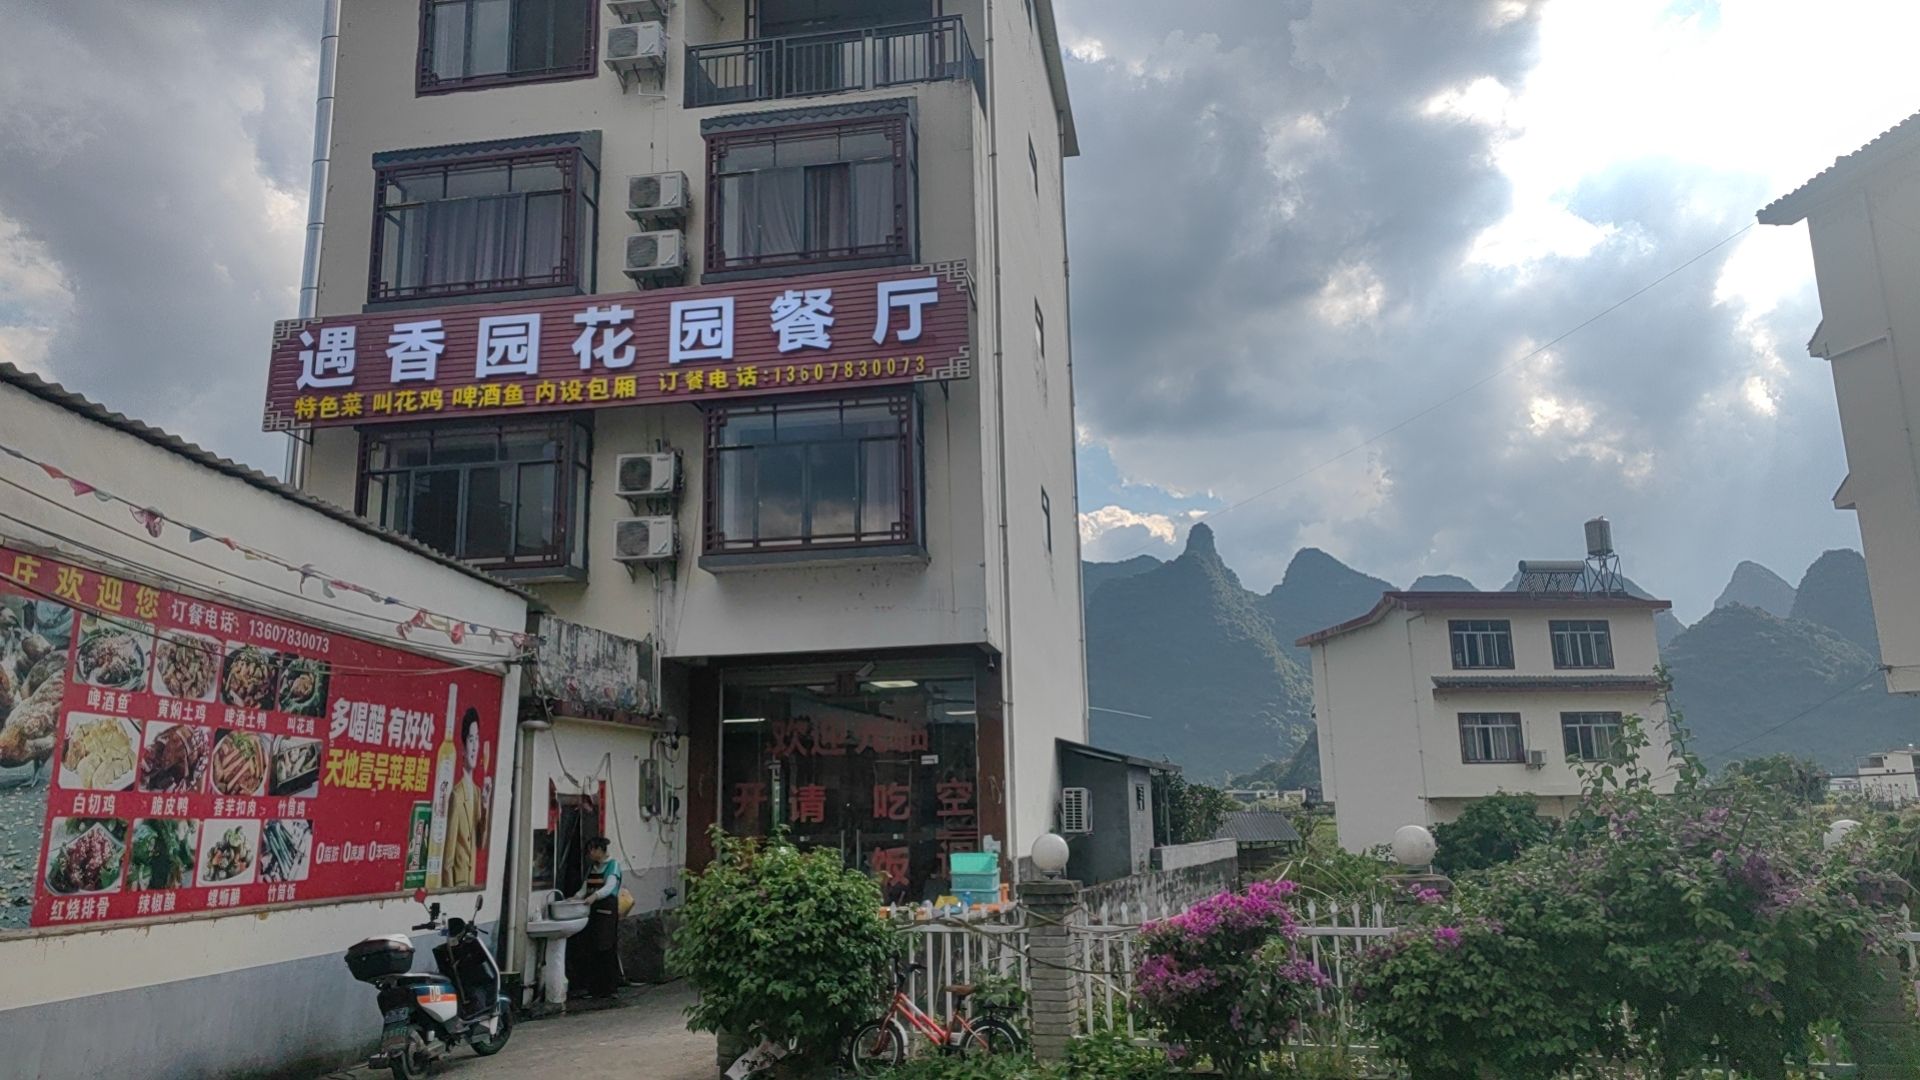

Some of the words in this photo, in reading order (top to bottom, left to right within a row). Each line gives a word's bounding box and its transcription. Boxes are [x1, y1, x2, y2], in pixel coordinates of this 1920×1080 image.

[296, 277, 939, 390] 遇香园花园餐厅
[294, 392, 363, 420] 特色菜
[372, 387, 443, 414] 叫花鸡
[452, 382, 525, 409] 啤酒鱼
[535, 374, 638, 402] 内设包厢
[12, 555, 161, 619] 庄欢迎您
[87, 687, 132, 714] 啤酒鱼
[224, 708, 267, 730] 啤酒土鸭
[287, 716, 315, 735] 叫花鸡
[329, 697, 386, 745] 多喝醋
[387, 706, 436, 752] 有好处
[323, 748, 431, 793] 天地壹号苹果醋
[72, 793, 116, 815] 白切鸡
[151, 794, 189, 816] 脆皮鸭
[213, 798, 257, 817] 香芋扣肉
[788, 783, 828, 824] 请
[137, 892, 176, 914] 辣椒酿
[267, 883, 296, 903] 竹筒饭
[50, 896, 110, 921] 红烧排骨
